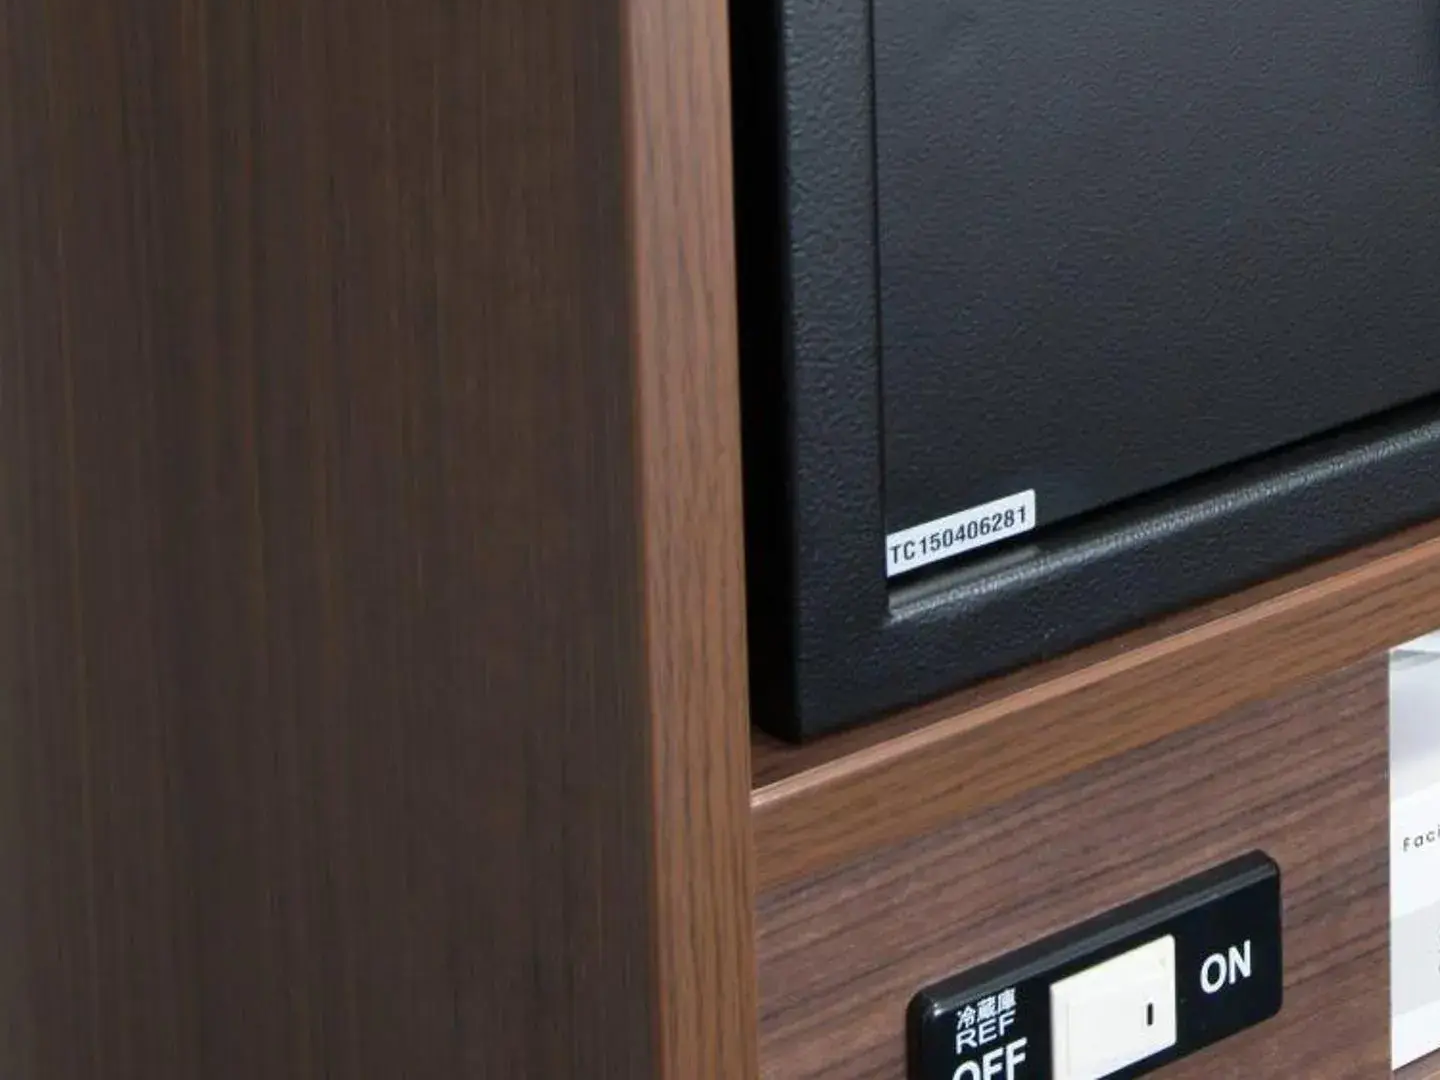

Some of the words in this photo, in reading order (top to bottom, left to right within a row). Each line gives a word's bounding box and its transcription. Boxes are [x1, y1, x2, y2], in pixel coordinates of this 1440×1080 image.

[889, 505, 1027, 565] TC150406281
[1200, 939, 1253, 994] ON
[955, 1009, 1016, 1055] REF
[956, 987, 1017, 1031] 冷蔵庫
[951, 1036, 1028, 1080] OFF
